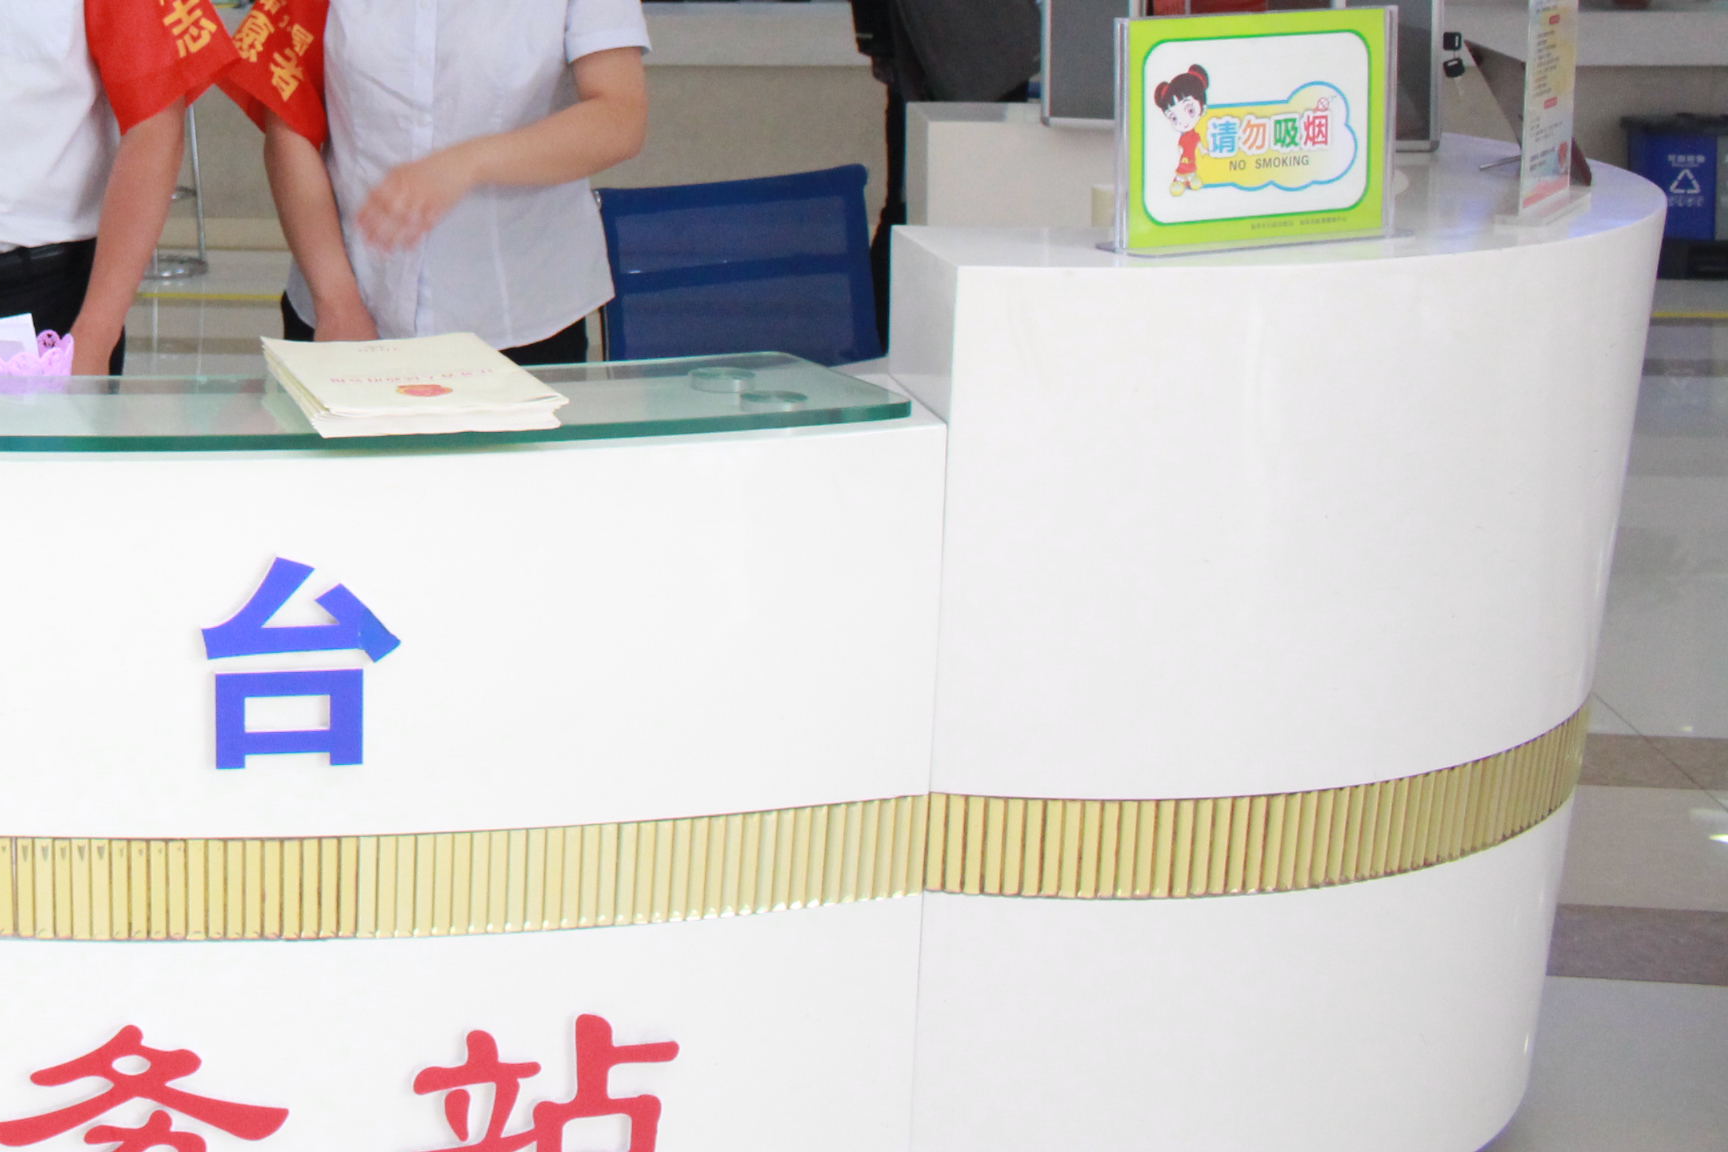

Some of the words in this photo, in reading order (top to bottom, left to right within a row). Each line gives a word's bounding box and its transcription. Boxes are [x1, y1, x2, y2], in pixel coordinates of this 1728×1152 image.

[1209, 113, 1329, 155] 请勿吸烟
[1229, 159, 1246, 171] NO
[1255, 155, 1310, 169] SMOKING
